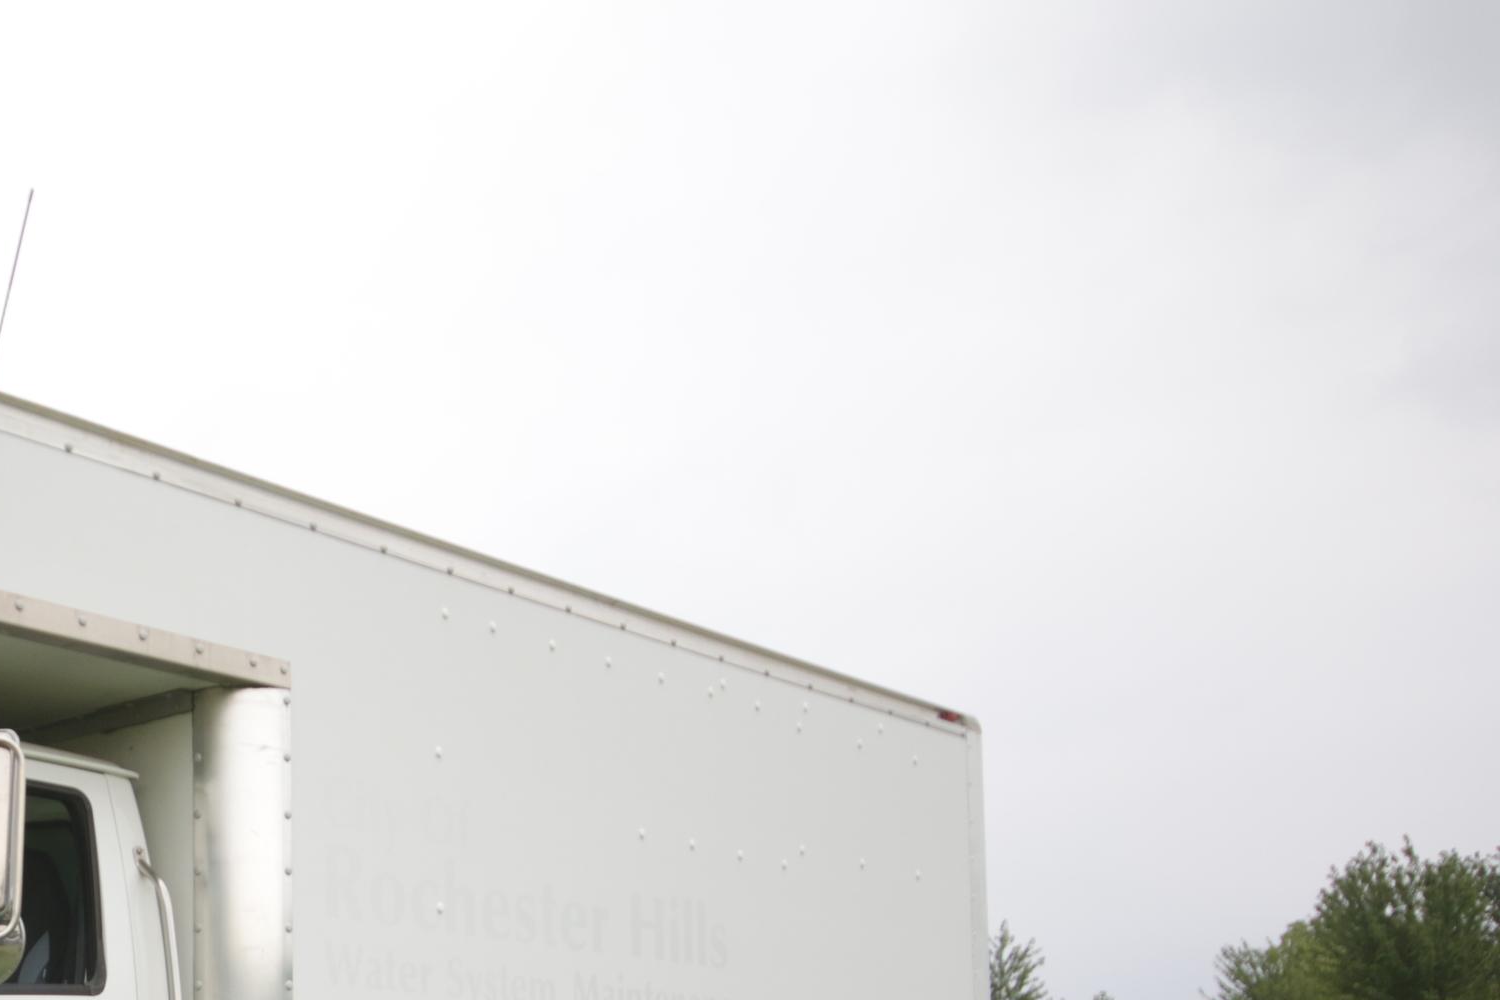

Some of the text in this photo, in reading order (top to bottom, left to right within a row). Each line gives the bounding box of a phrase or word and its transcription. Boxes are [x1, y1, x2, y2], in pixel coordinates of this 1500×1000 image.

[325, 842, 730, 970] Rochester Hills
[324, 939, 434, 997] Water
